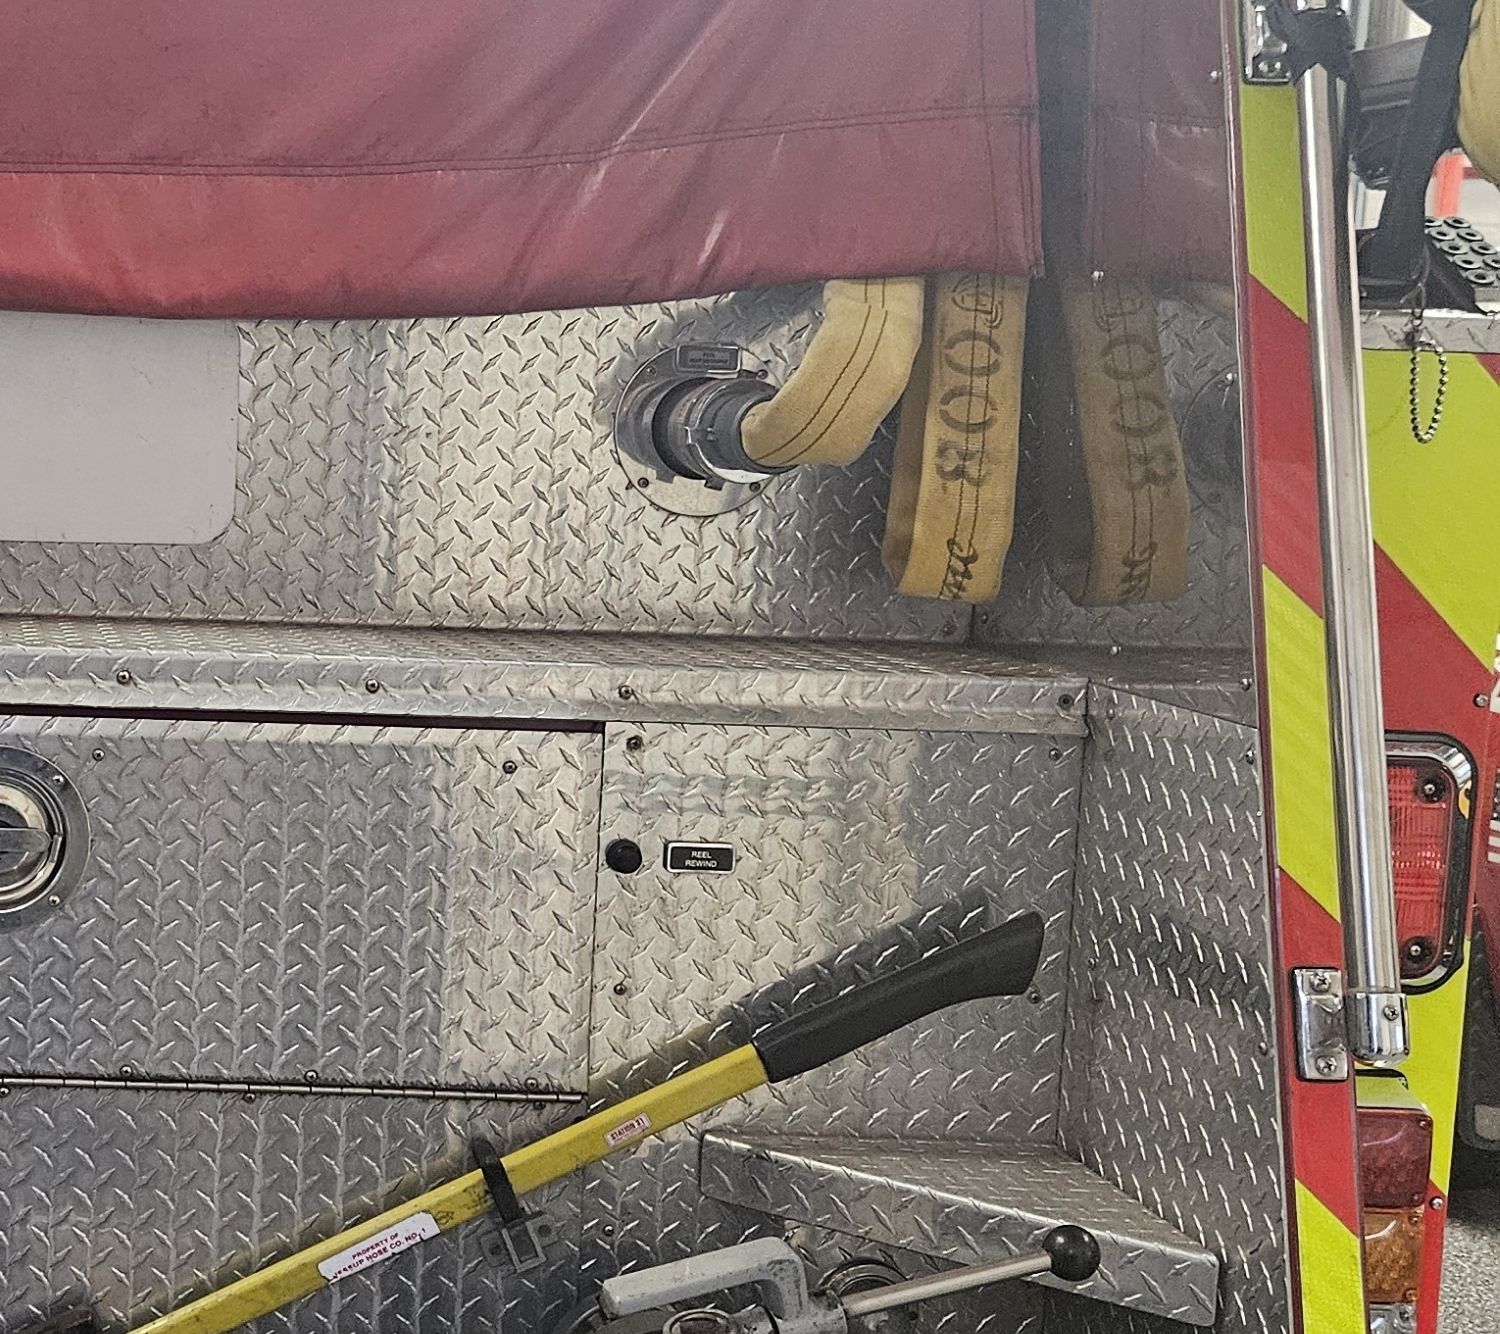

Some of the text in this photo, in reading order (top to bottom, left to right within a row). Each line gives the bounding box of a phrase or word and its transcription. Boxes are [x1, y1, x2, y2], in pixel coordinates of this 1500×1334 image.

[691, 850, 712, 858] REEL
[685, 859, 717, 868] REWIND
[352, 1232, 399, 1260] PROPERTY OF
[365, 1246, 389, 1261] HOSE
